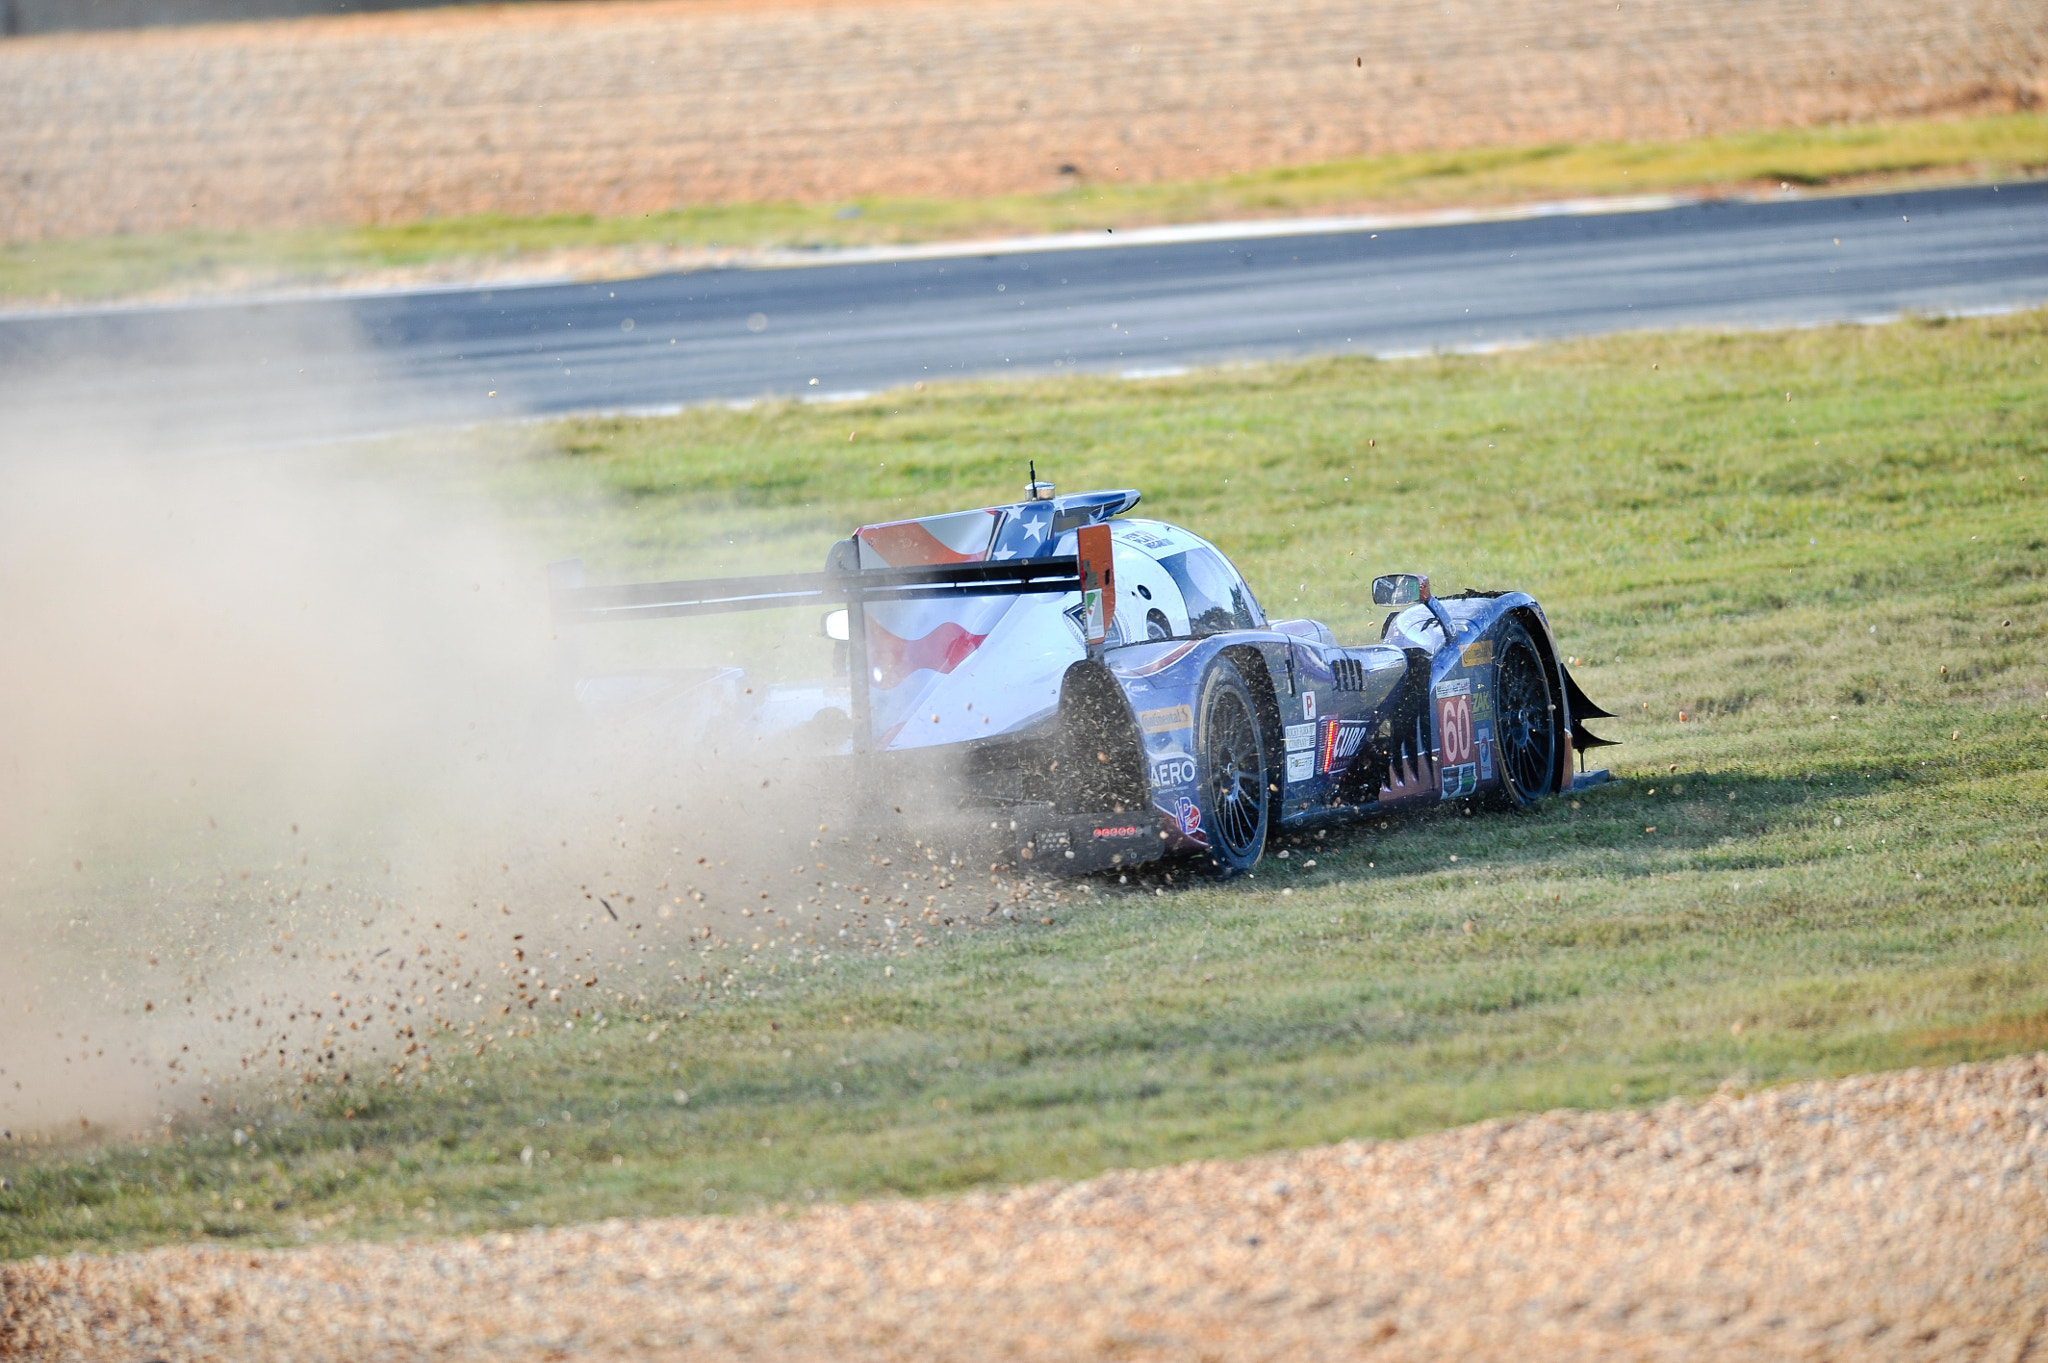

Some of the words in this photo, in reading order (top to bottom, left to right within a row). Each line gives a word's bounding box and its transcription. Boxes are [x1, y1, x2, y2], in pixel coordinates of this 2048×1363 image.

[1306, 695, 1312, 716] P
[1473, 691, 1491, 712] ZAK
[1141, 708, 1181, 731] Continental
[1444, 698, 1471, 762] 60
[1333, 727, 1367, 758] CURB
[1151, 760, 1196, 787] AERO
[1174, 797, 1192, 835] VP
